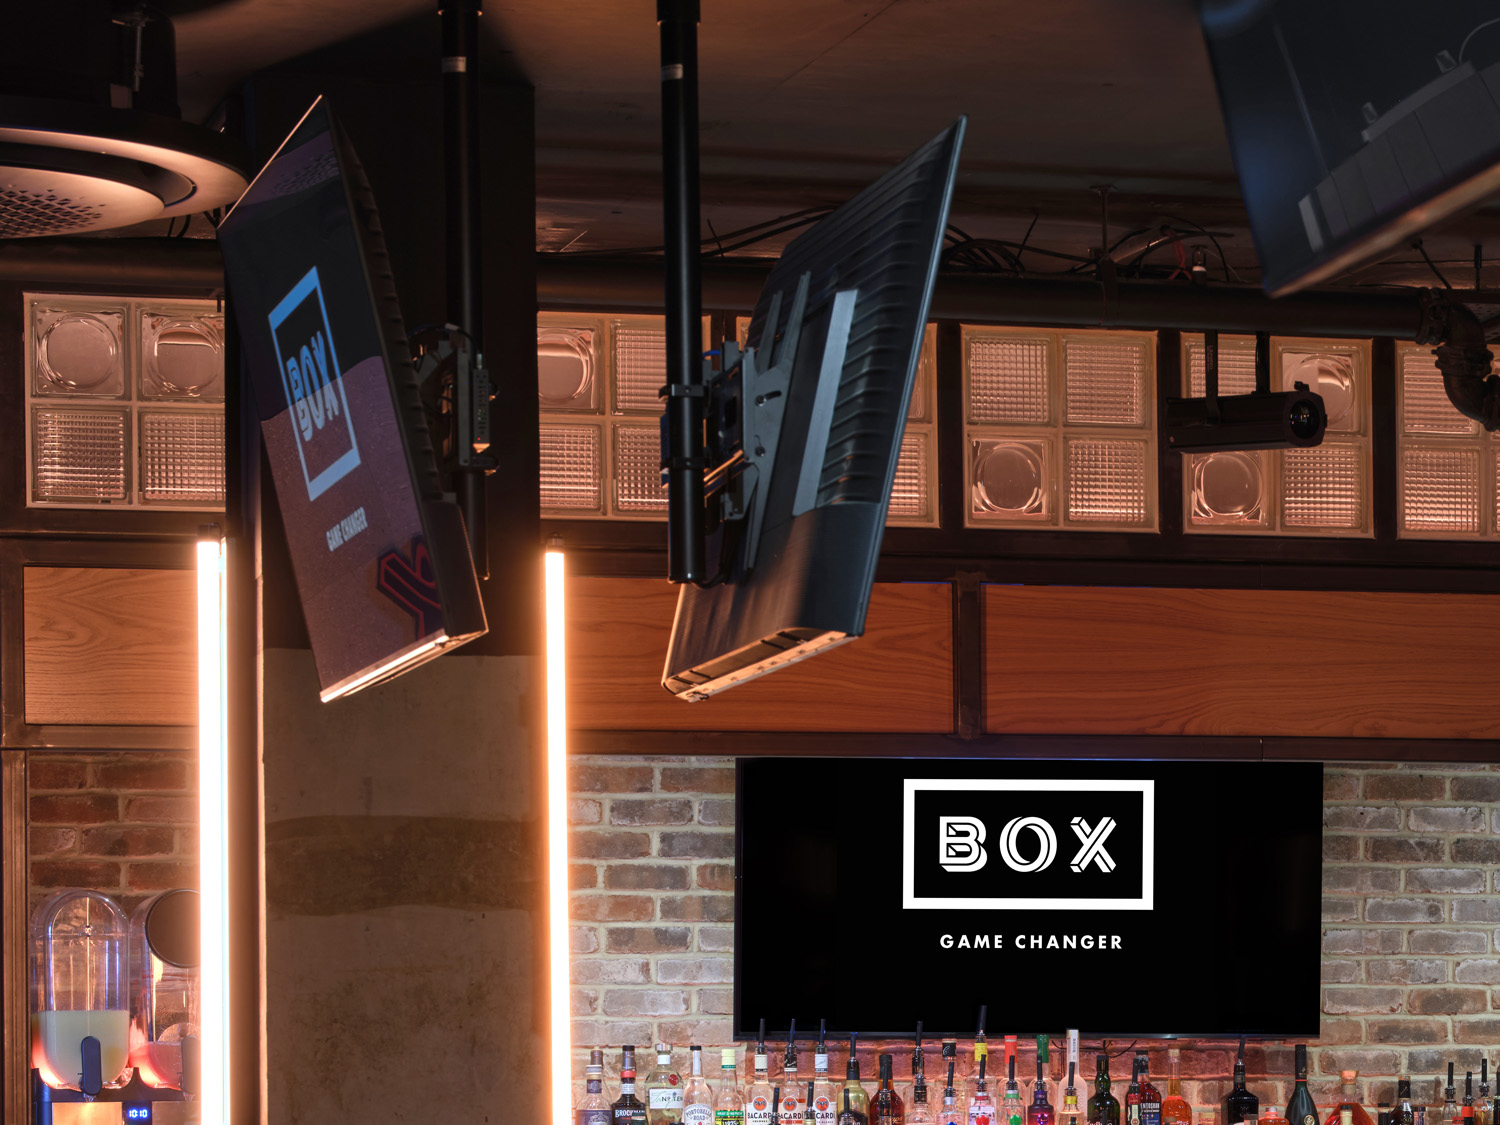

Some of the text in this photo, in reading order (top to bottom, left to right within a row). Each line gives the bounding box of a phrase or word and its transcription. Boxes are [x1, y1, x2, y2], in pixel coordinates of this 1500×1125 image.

[286, 331, 339, 442] BOX
[326, 506, 368, 552] GAME CHANGER
[939, 816, 1117, 873] BOX
[940, 934, 1122, 949] GAME CHANGER
